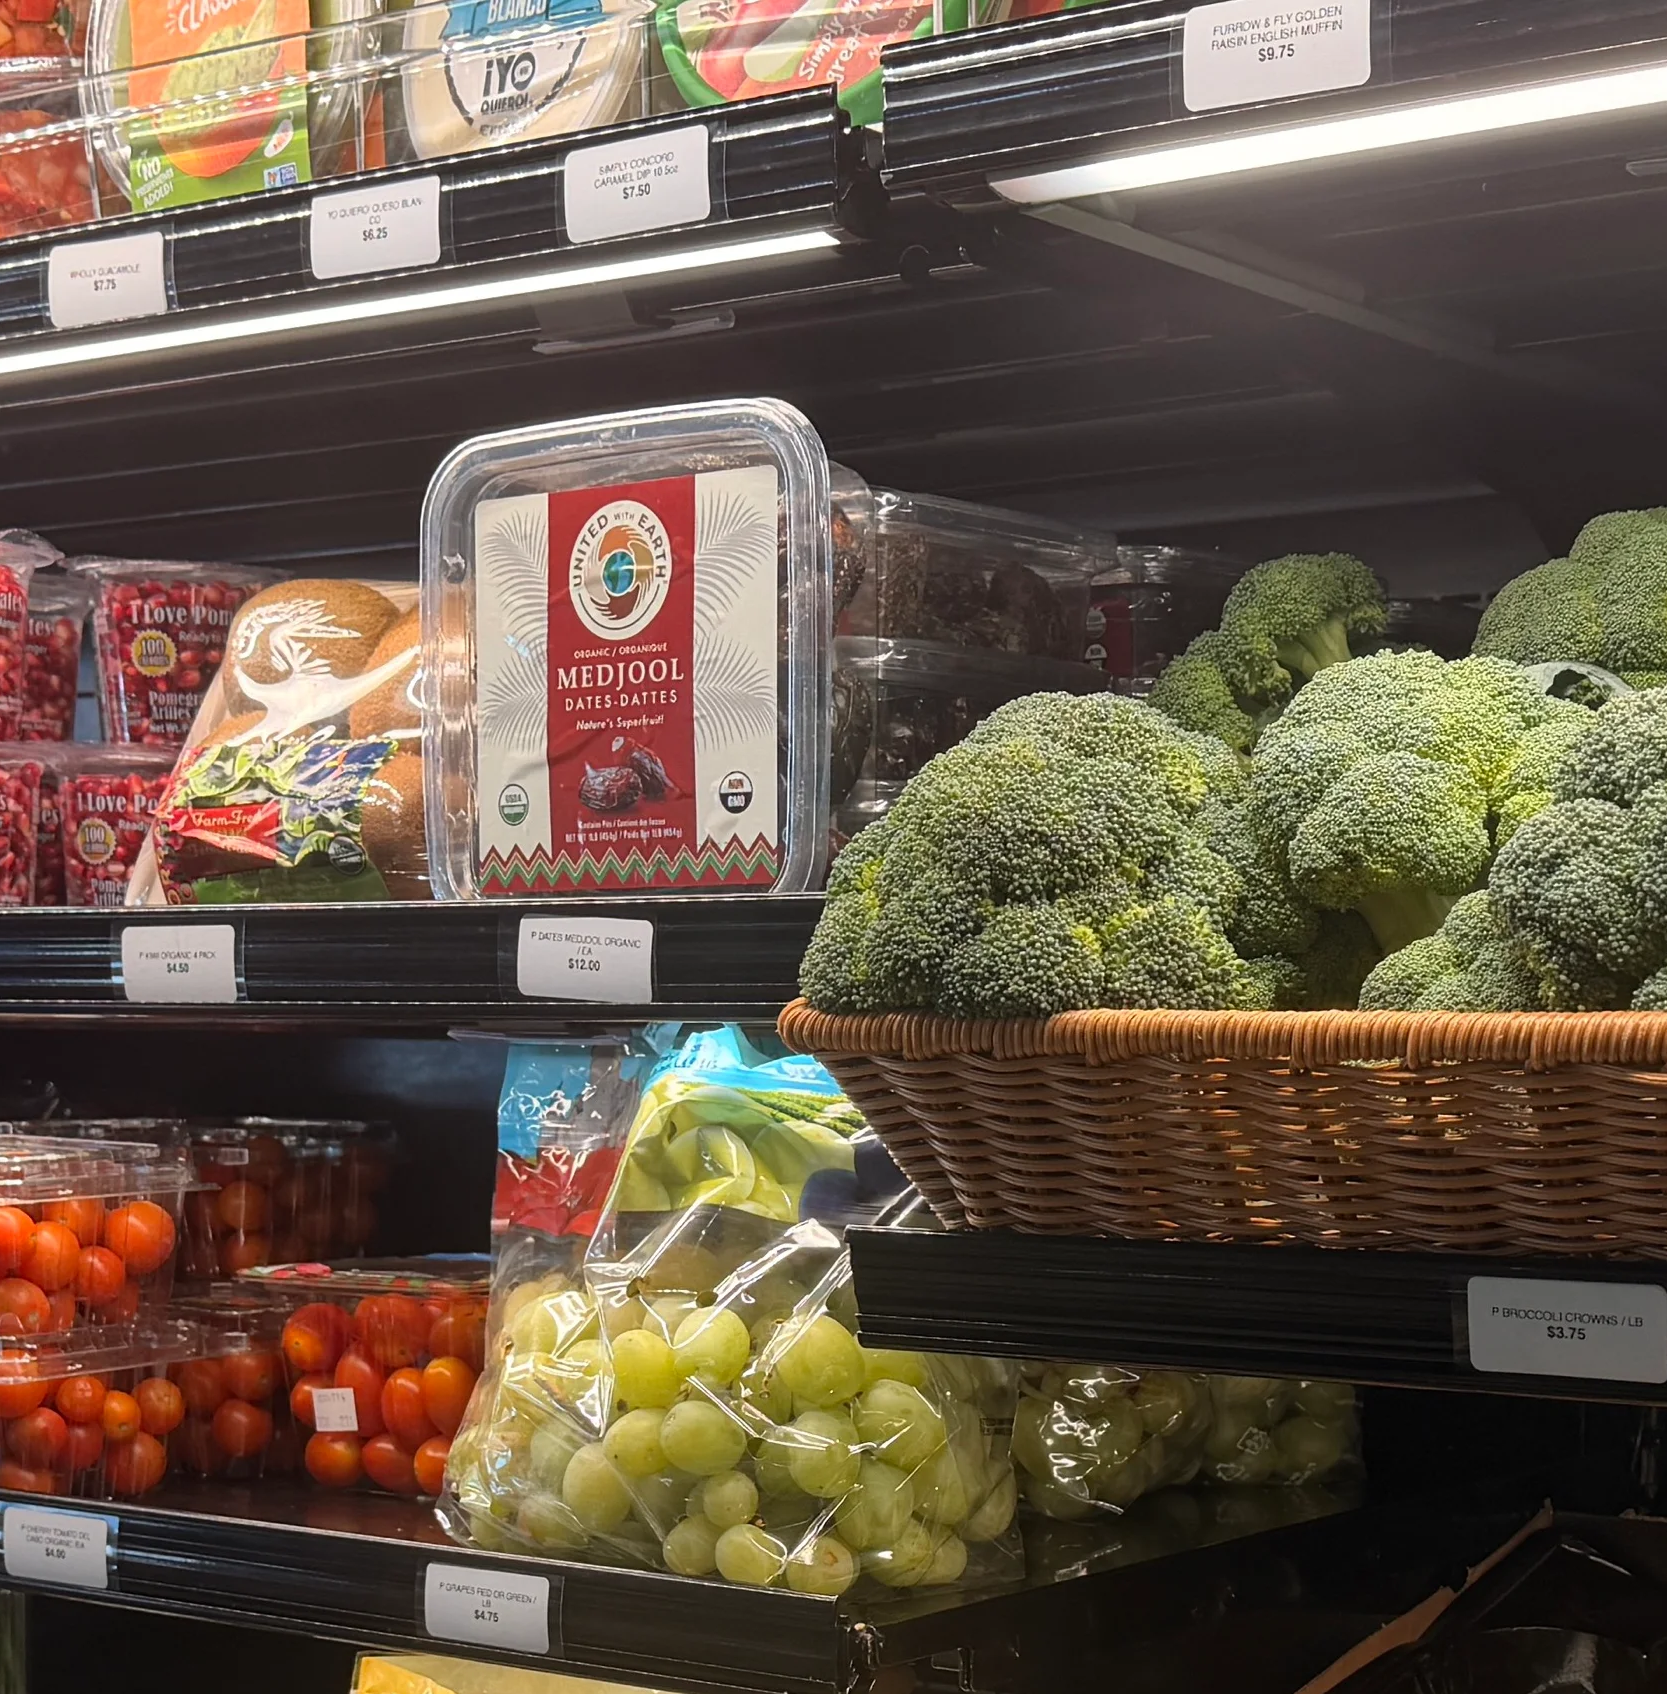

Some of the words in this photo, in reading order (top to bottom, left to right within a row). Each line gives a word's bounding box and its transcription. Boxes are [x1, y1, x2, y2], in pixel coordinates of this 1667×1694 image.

[1213, 17, 1263, 37] FURROW
[1264, 17, 1270, 29] &
[1274, 13, 1293, 26] FLY
[1295, 5, 1343, 23] GOLDEN
[1211, 33, 1248, 51] RAISIN
[1250, 27, 1297, 45] ENGLISH
[1300, 19, 1343, 37] MUFFIN
[1258, 44, 1294, 62] $9.75
[598, 159, 631, 176] SIMPLY
[632, 151, 675, 169] CONCORD
[593, 169, 634, 189] CARAMEL
[635, 168, 651, 181] DIP
[622, 184, 651, 199] $7.50
[371, 201, 399, 215] QUESO
[362, 228, 388, 242] $6.25
[94, 279, 117, 291] $7.75
[573, 512, 609, 588] UNITED
[613, 510, 635, 522] WITH
[637, 512, 667, 579] EARTH
[143, 603, 188, 625] Love
[141, 637, 166, 657] 100
[179, 631, 211, 646] Ready
[574, 647, 611, 659] ORGANIC
[619, 642, 668, 656] ORGANIQUE
[556, 657, 685, 691] MEDJOOL
[565, 689, 678, 712] DATES-DATTES
[576, 718, 614, 731] Nature's
[616, 714, 664, 729] Superfruit!
[87, 792, 127, 813] Love
[192, 811, 227, 827] Farm
[84, 826, 104, 843] 100
[538, 931, 563, 942] DATES
[565, 934, 602, 946] MEDJOOL
[604, 937, 642, 949] ORGANIC
[161, 951, 192, 960] ORGANIC
[199, 951, 217, 960] PACK
[167, 962, 190, 974] $4.50
[568, 957, 601, 972] $12.00
[1491, 1306, 1500, 1318] P
[1502, 1307, 1563, 1322] BROCCOLI
[1565, 1311, 1619, 1327] CROWNS
[1628, 1316, 1644, 1328] LB
[1546, 1325, 1586, 1342] $3.75
[445, 1582, 476, 1597] GRAPES
[477, 1587, 494, 1598] RED
[493, 1589, 506, 1601] OR
[506, 1592, 533, 1605] GREEN
[481, 1598, 492, 1608] LB
[474, 1608, 500, 1624] $4.75
